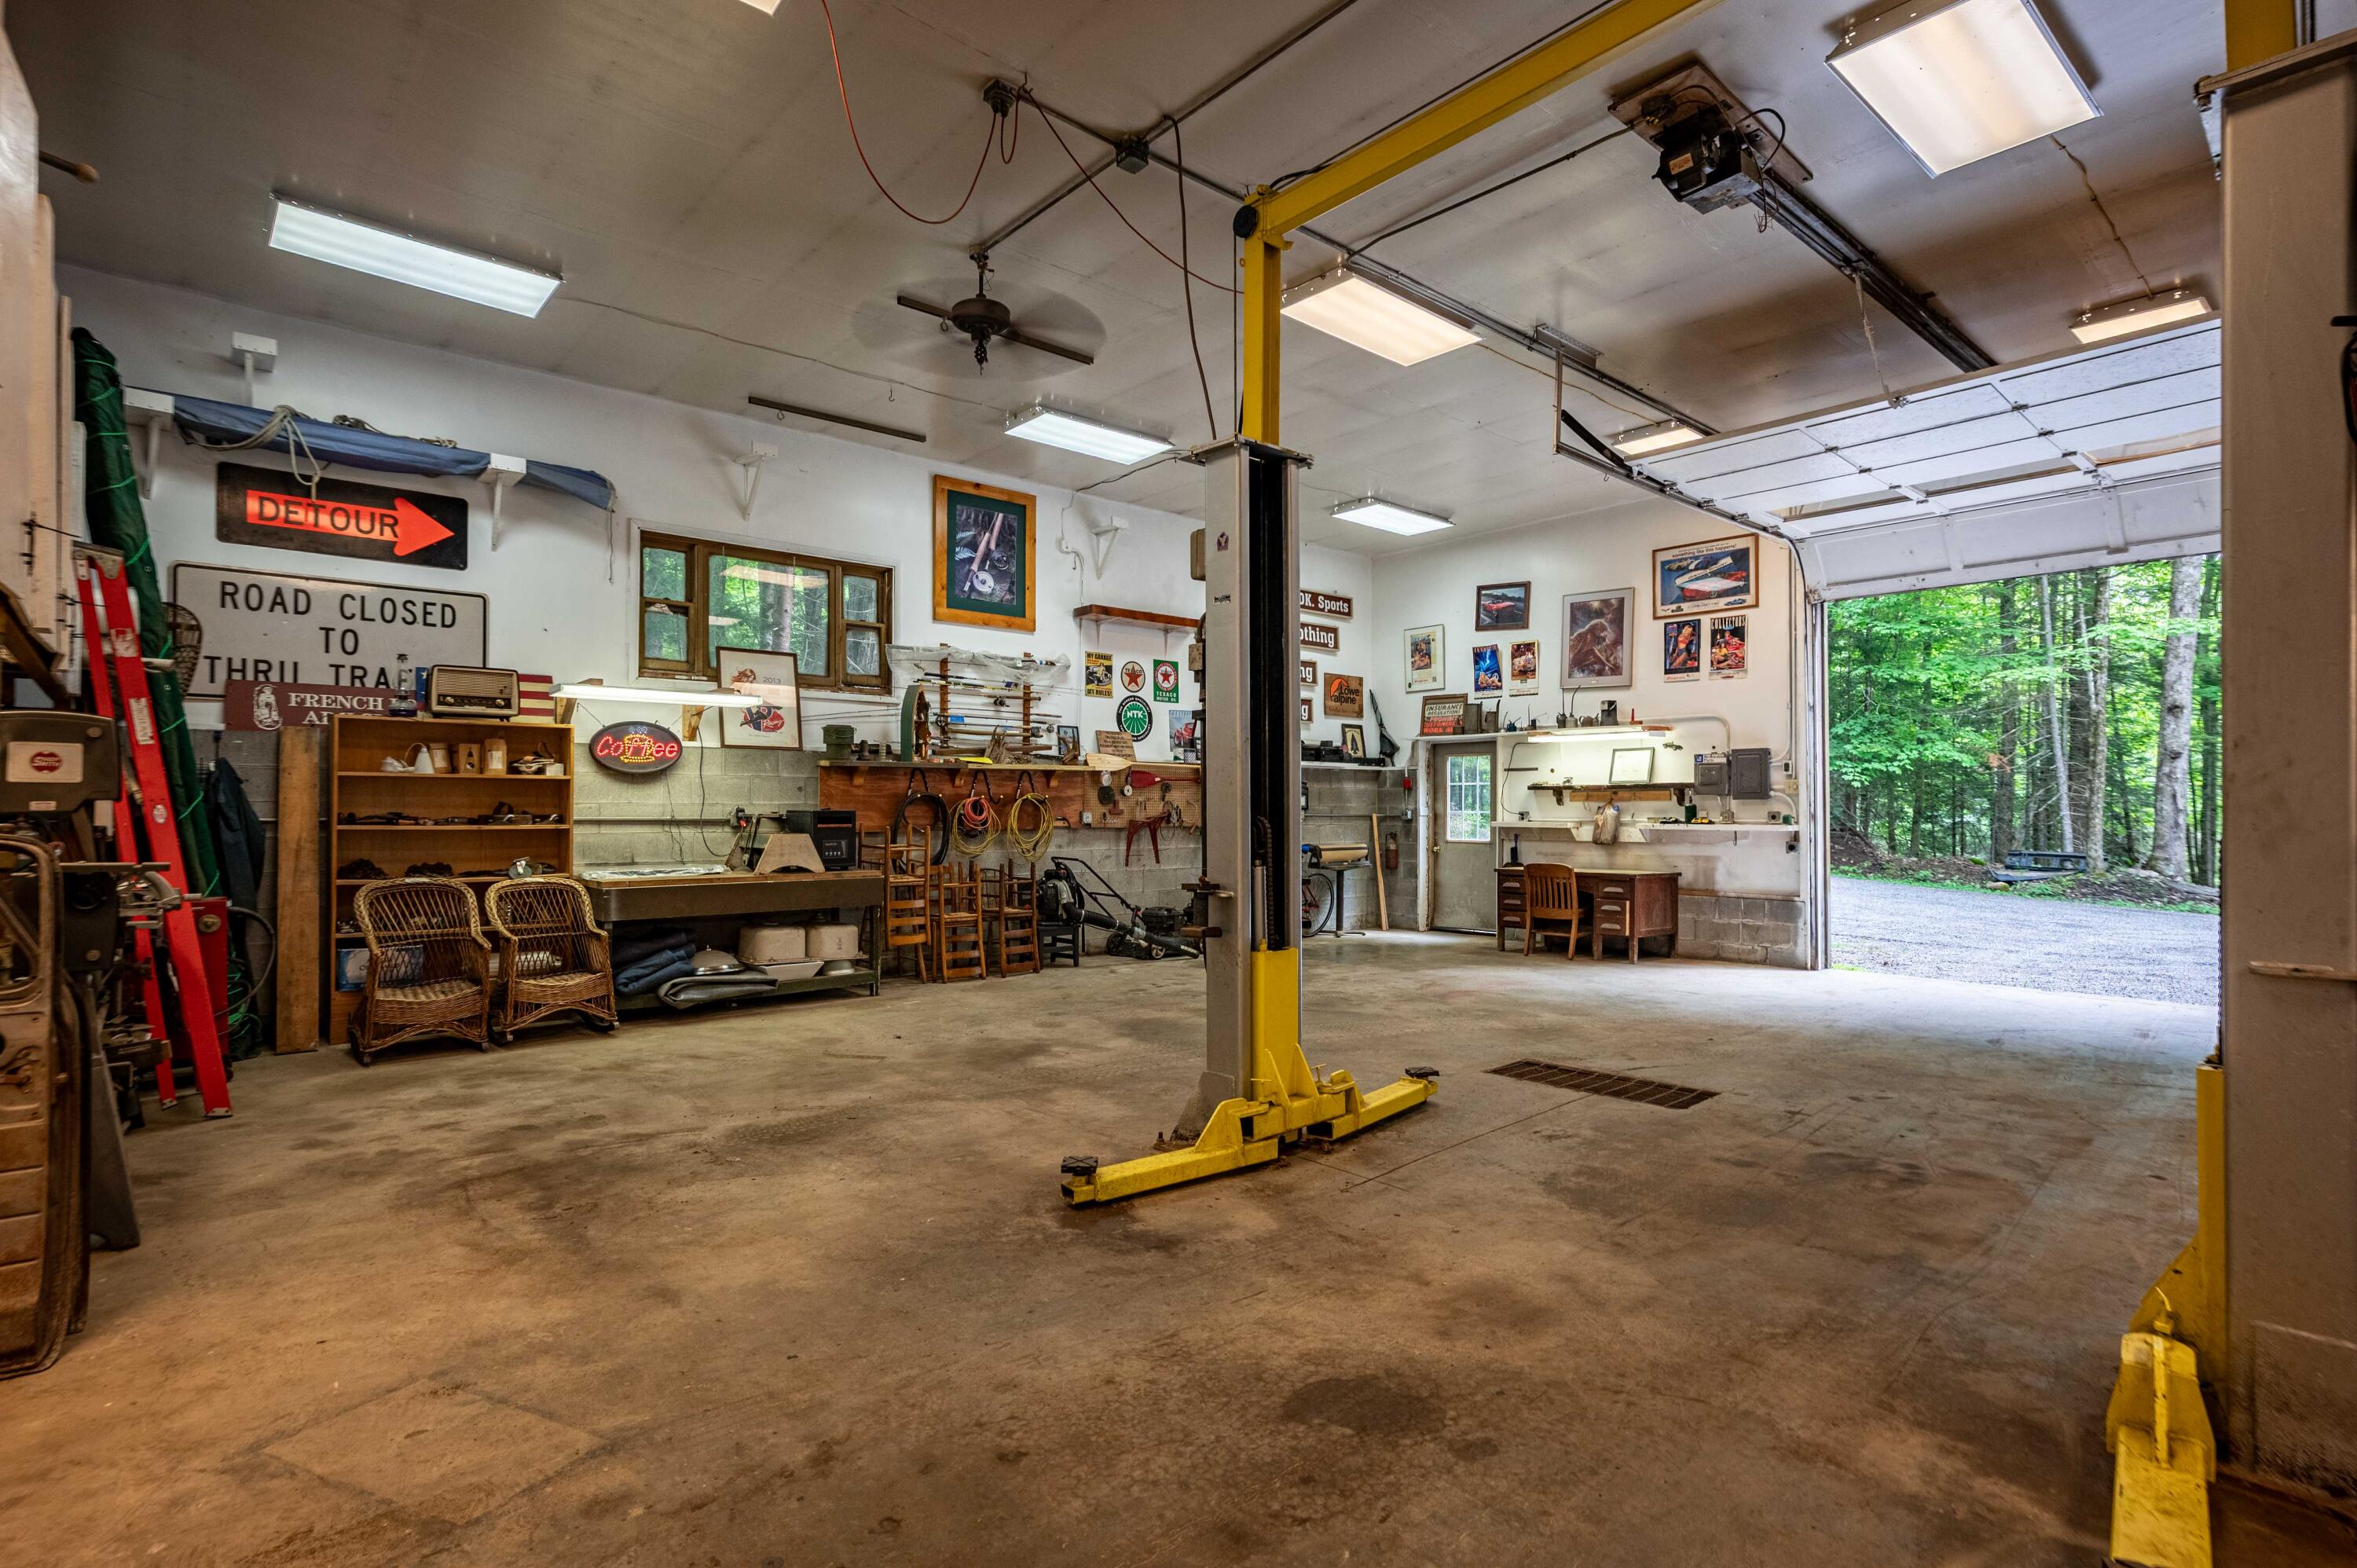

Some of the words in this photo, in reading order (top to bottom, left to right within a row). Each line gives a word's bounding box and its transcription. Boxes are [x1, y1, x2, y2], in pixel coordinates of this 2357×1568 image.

[258, 496, 399, 538] DETOUR
[220, 580, 311, 615] ROAD
[340, 593, 457, 628] CLOSED
[1318, 595, 1349, 613] Sports
[319, 627, 359, 655] TO
[1299, 626, 1335, 648] othing
[1094, 653, 1113, 662] GARAGE
[203, 655, 300, 683] THRU
[1340, 683, 1359, 697] Lowe
[288, 692, 385, 711] FRENCH
[1333, 693, 1357, 706] alpine
[1427, 703, 1463, 712] INSURANCE
[1127, 710, 1144, 719] NTK
[763, 719, 785, 729] Racing
[597, 735, 678, 757] Coffee
